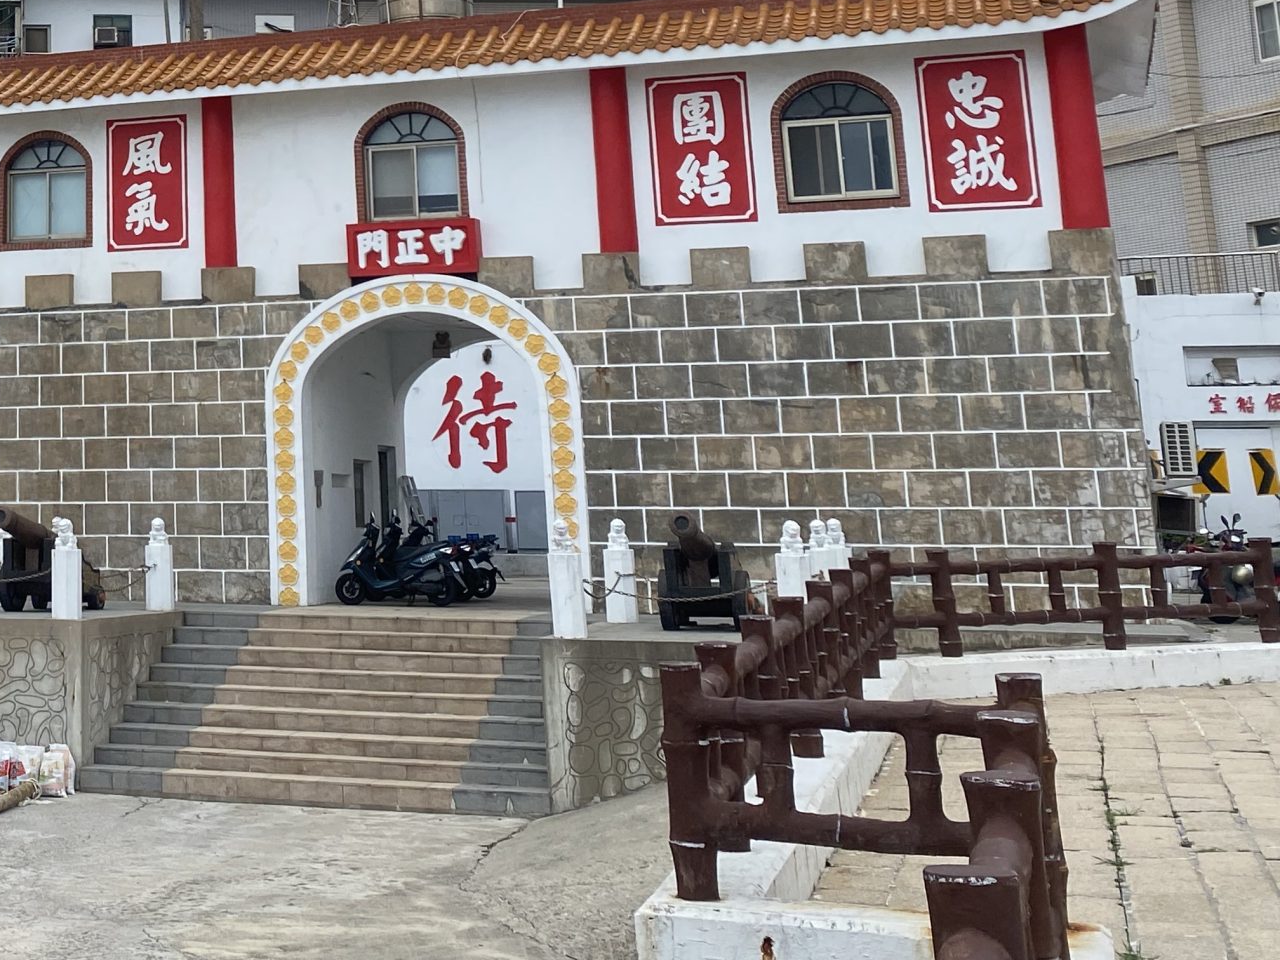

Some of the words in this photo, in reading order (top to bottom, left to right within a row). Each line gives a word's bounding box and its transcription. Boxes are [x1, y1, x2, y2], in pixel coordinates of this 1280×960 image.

[122, 131, 172, 236] 風氣
[672, 91, 732, 207] 團結
[945, 71, 1018, 195] 忠誠
[356, 225, 467, 269] 中正門
[431, 371, 518, 474] 待
